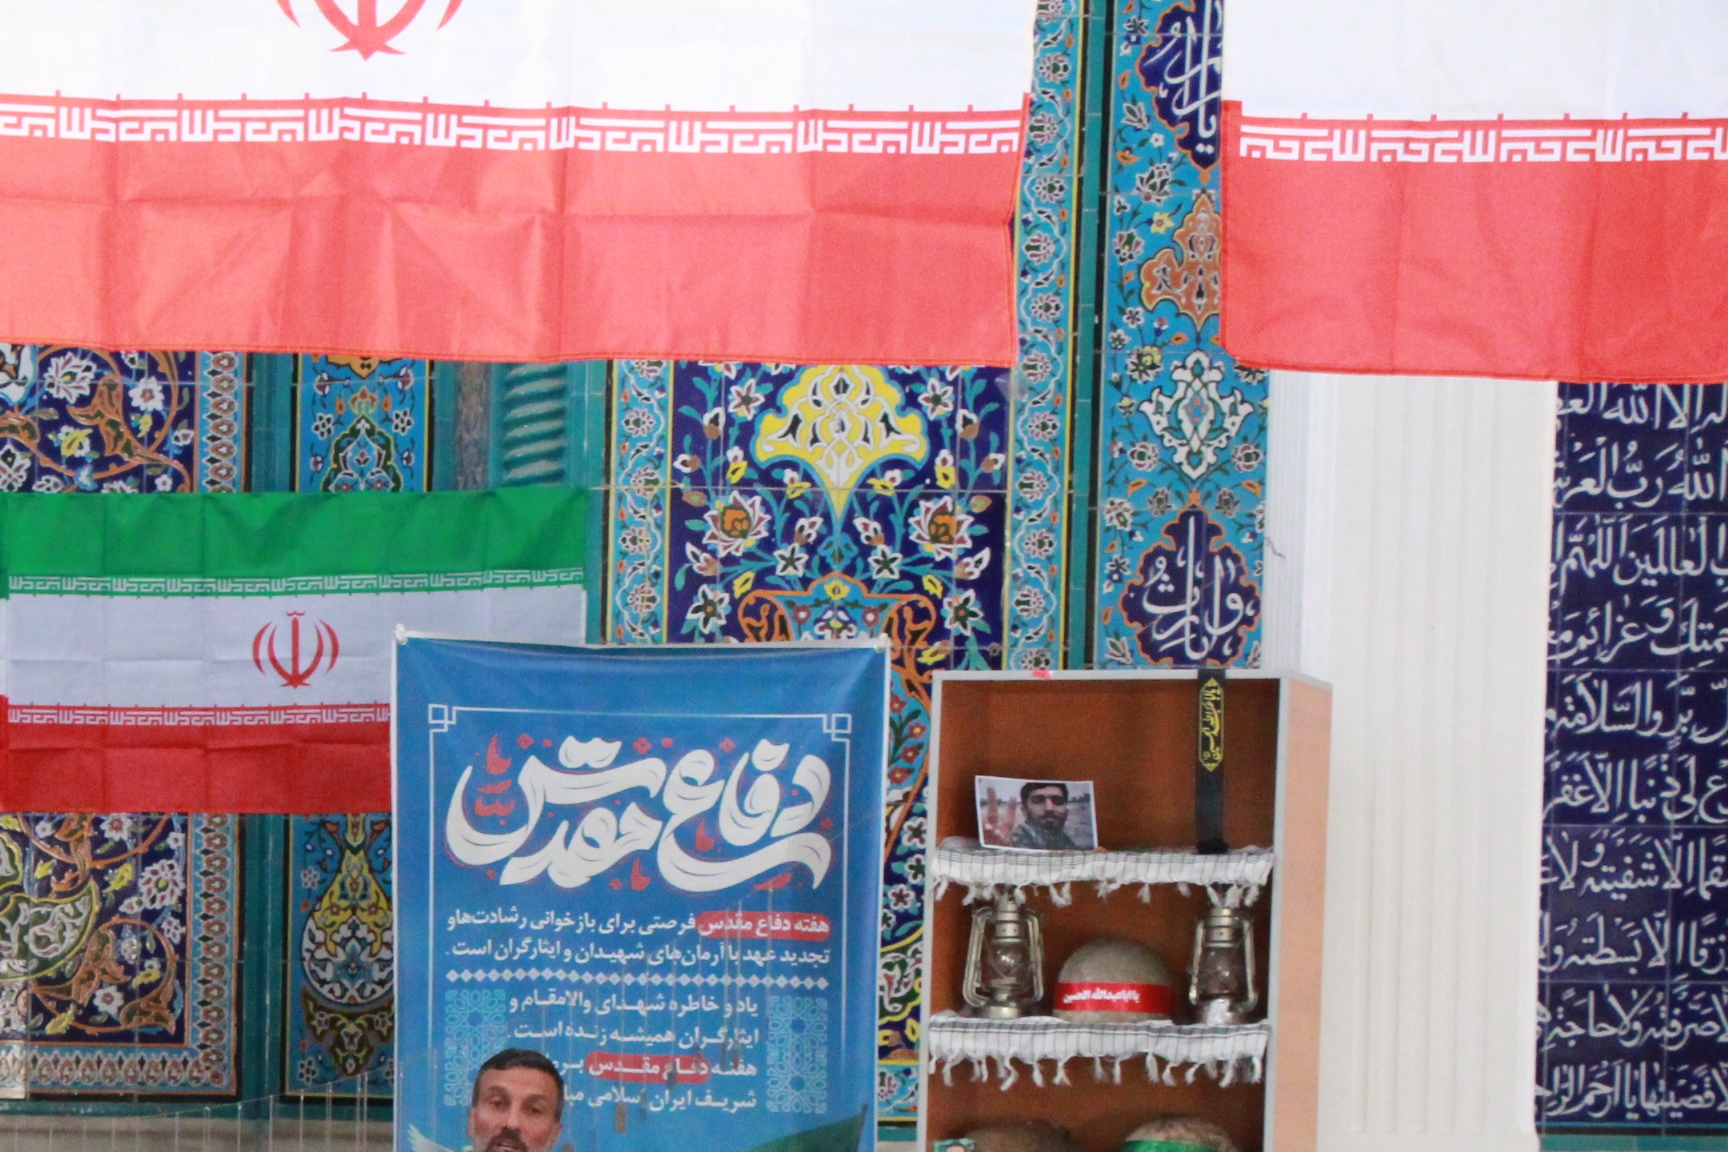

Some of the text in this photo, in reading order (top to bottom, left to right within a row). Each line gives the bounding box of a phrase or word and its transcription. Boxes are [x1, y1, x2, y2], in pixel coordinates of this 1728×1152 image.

[598, 912, 637, 934] برای
[638, 912, 697, 936] فرصتی
[698, 911, 753, 937] مقدس
[755, 914, 792, 937] دفاع
[794, 915, 830, 933] هفته
[494, 935, 561, 961] ایثارگران
[563, 949, 573, 963] و
[575, 941, 646, 965] شهیدان
[728, 945, 740, 966] با
[743, 950, 776, 967] عهد
[780, 949, 831, 967] تجدید
[509, 987, 759, 1018] یاد و خاطره شهدای والامقام و
[565, 1024, 608, 1047] زنده
[610, 1026, 676, 1047] همیشه
[678, 1024, 760, 1050] ایثارگران
[589, 1056, 661, 1076] مقدس
[711, 1058, 759, 1077] هفته
[649, 1088, 693, 1112] ایران
[695, 1089, 758, 1113] شریف
